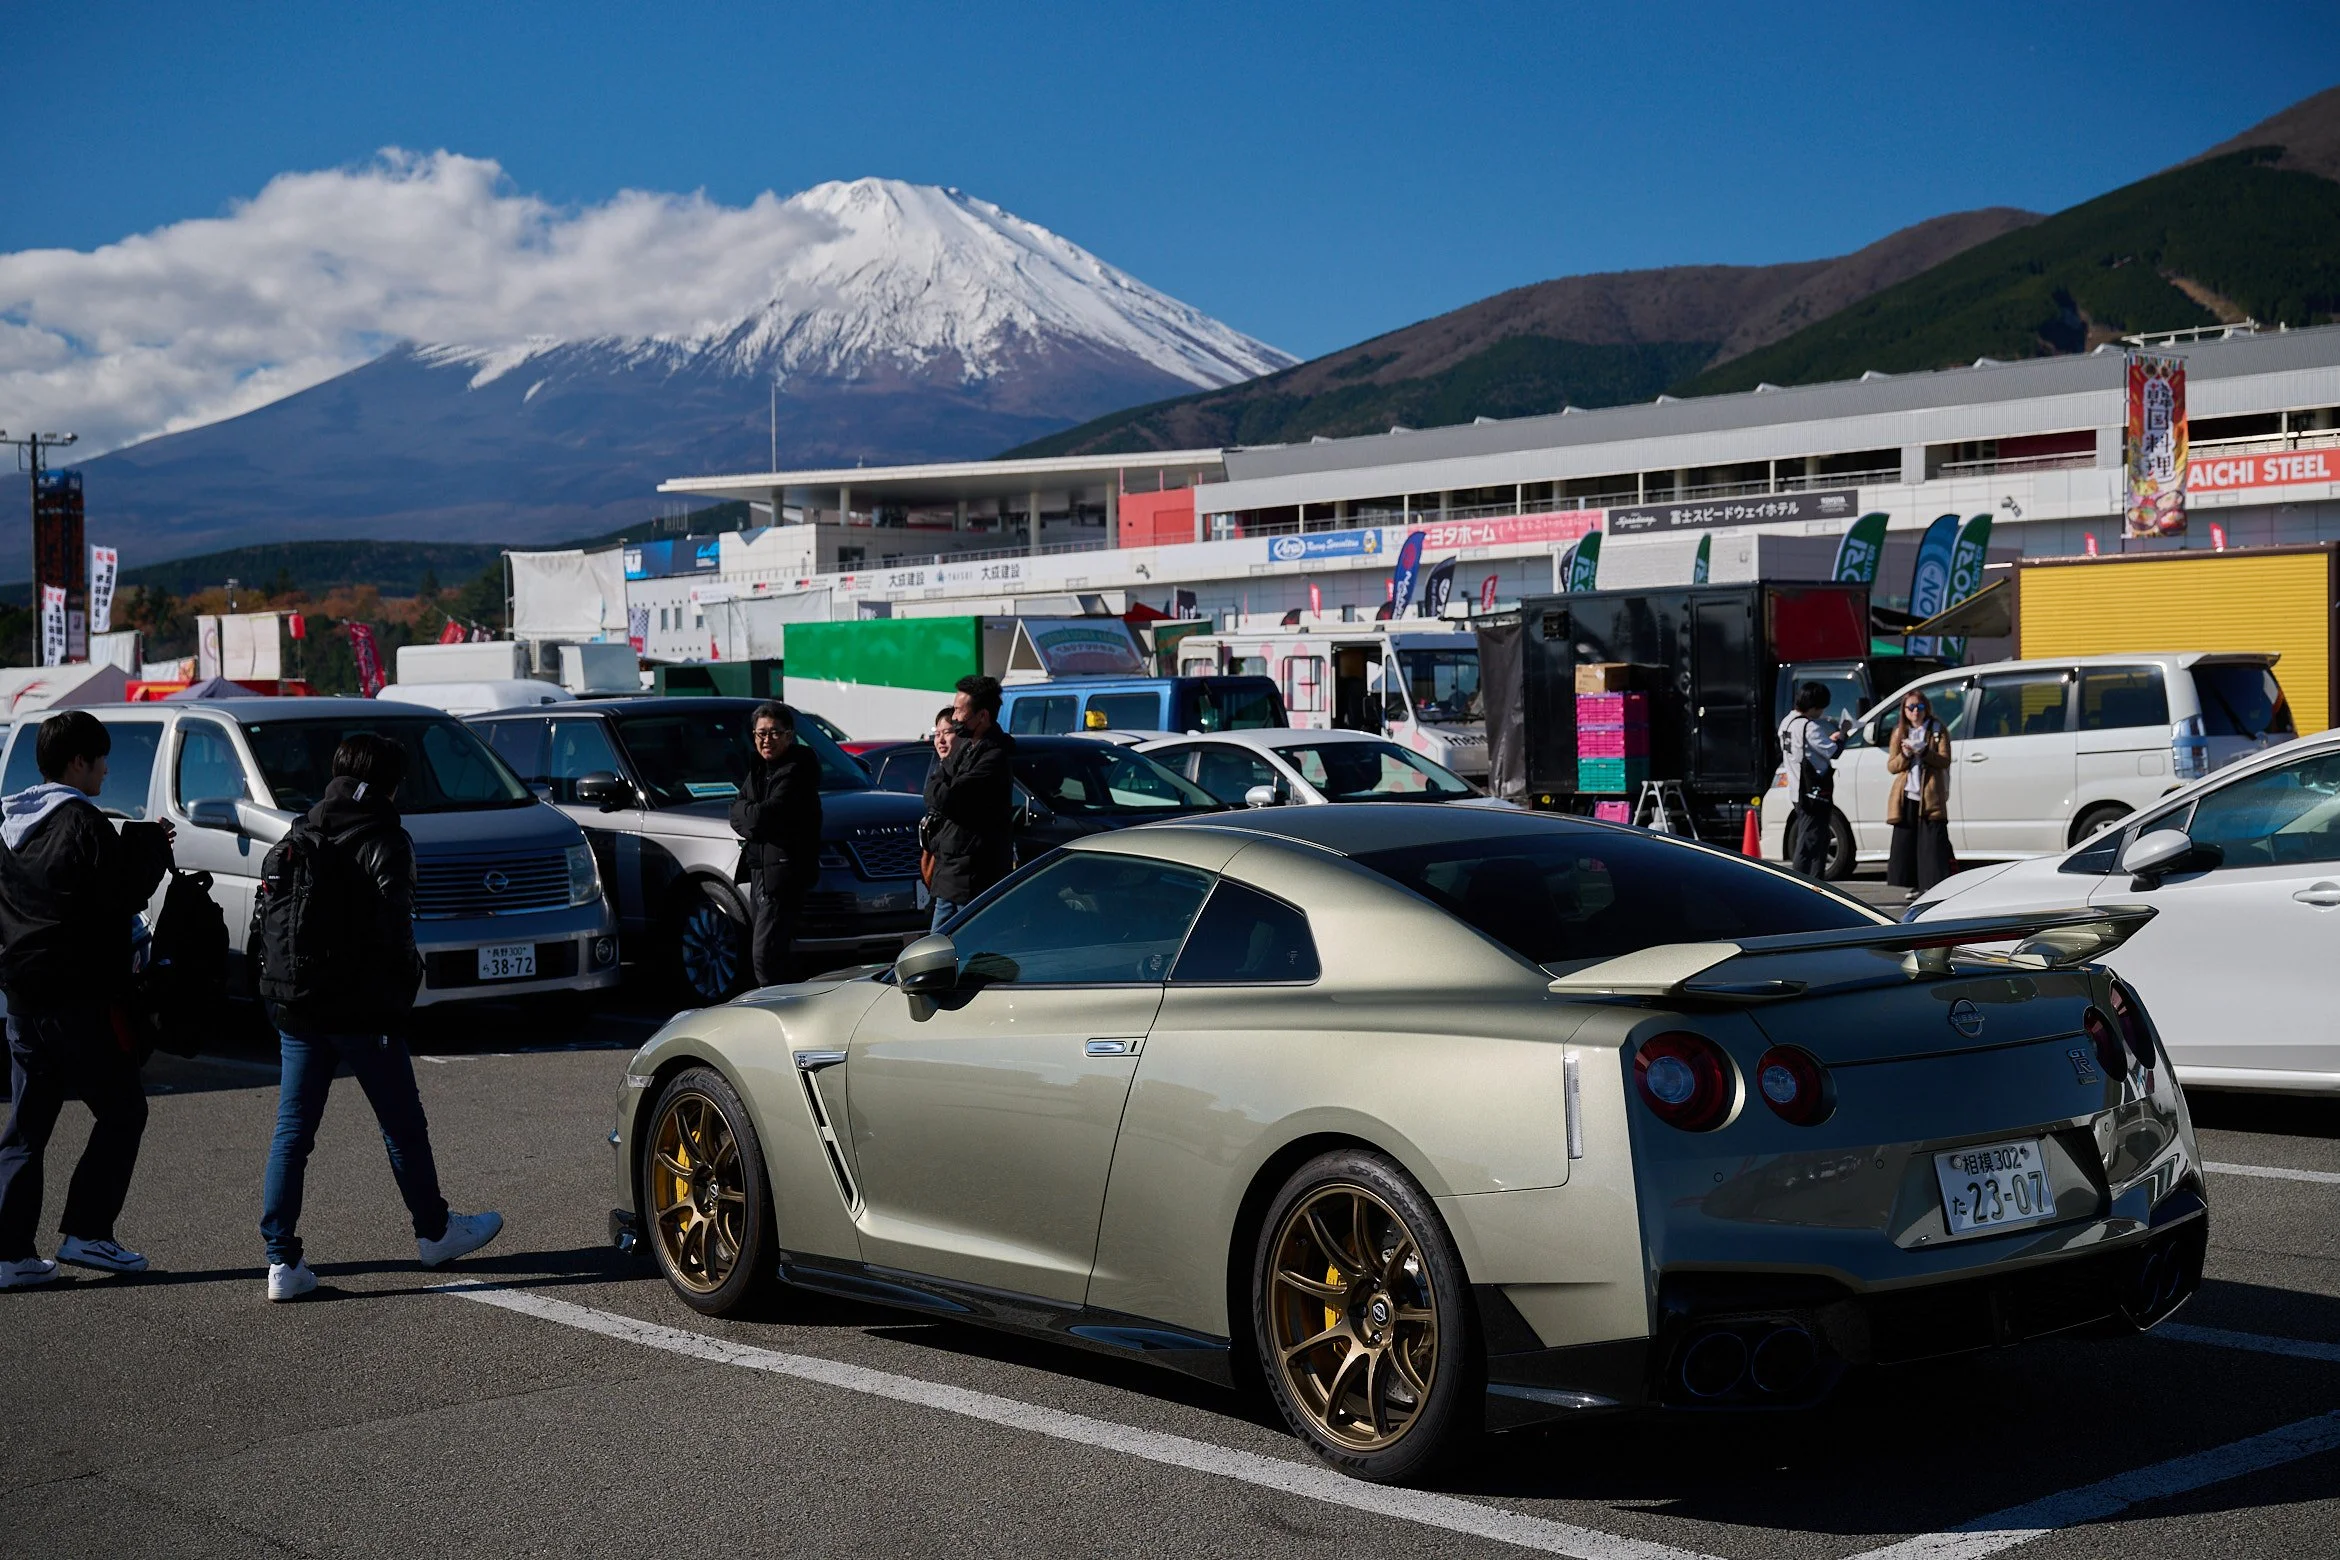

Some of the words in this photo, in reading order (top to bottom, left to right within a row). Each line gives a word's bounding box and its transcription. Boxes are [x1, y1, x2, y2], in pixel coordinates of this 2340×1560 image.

[2146, 382, 2174, 477] 韓国料理
[2187, 460, 2254, 488] AICHI
[2263, 454, 2331, 483] STEEL
[1669, 501, 1800, 525] 富士スピードウェイホテル
[888, 571, 925, 587] 大成建設
[981, 564, 1020, 581] 大成建設
[491, 956, 533, 976] 38-72
[1952, 1196, 1968, 1216] た
[1967, 1170, 2044, 1224] 23-07
